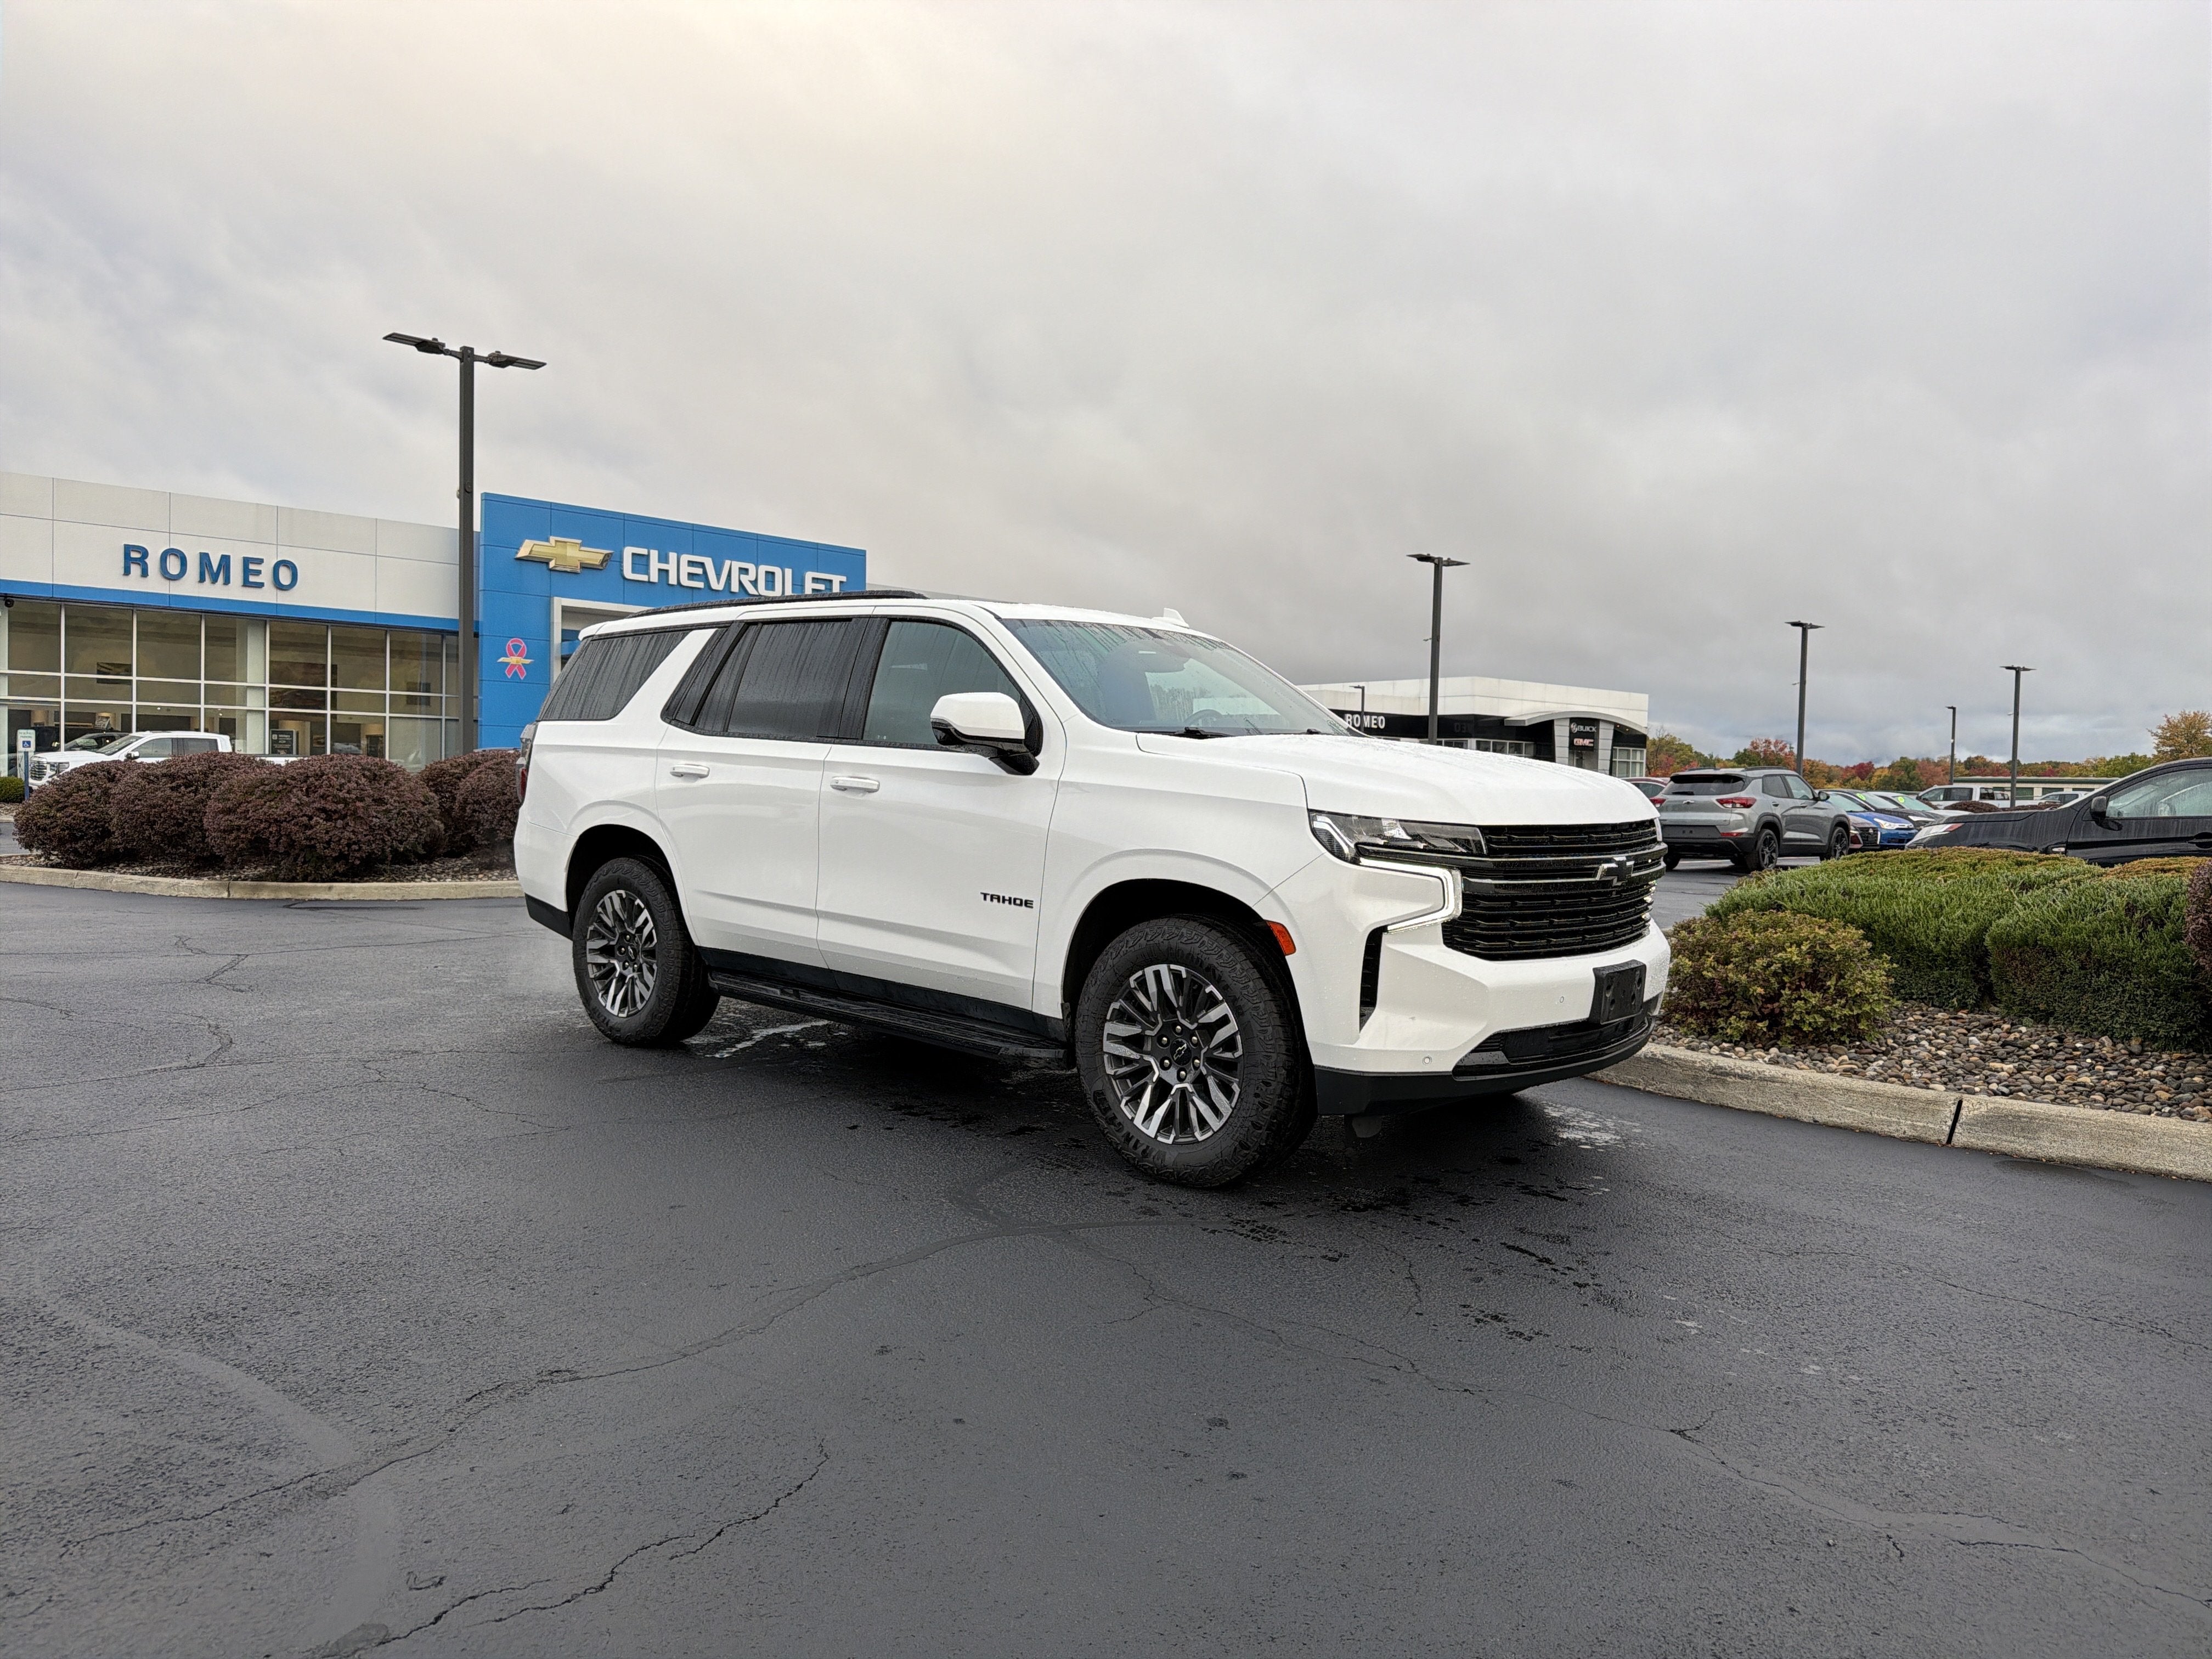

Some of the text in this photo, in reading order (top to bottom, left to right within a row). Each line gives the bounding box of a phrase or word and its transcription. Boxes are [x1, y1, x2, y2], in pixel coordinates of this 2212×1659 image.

[123, 544, 298, 590] ROMEO
[623, 546, 847, 596] CHEVROLET
[1345, 714, 1385, 729] ROMEO
[1573, 738, 1594, 746] GMC
[980, 891, 1034, 909] TAHOE
